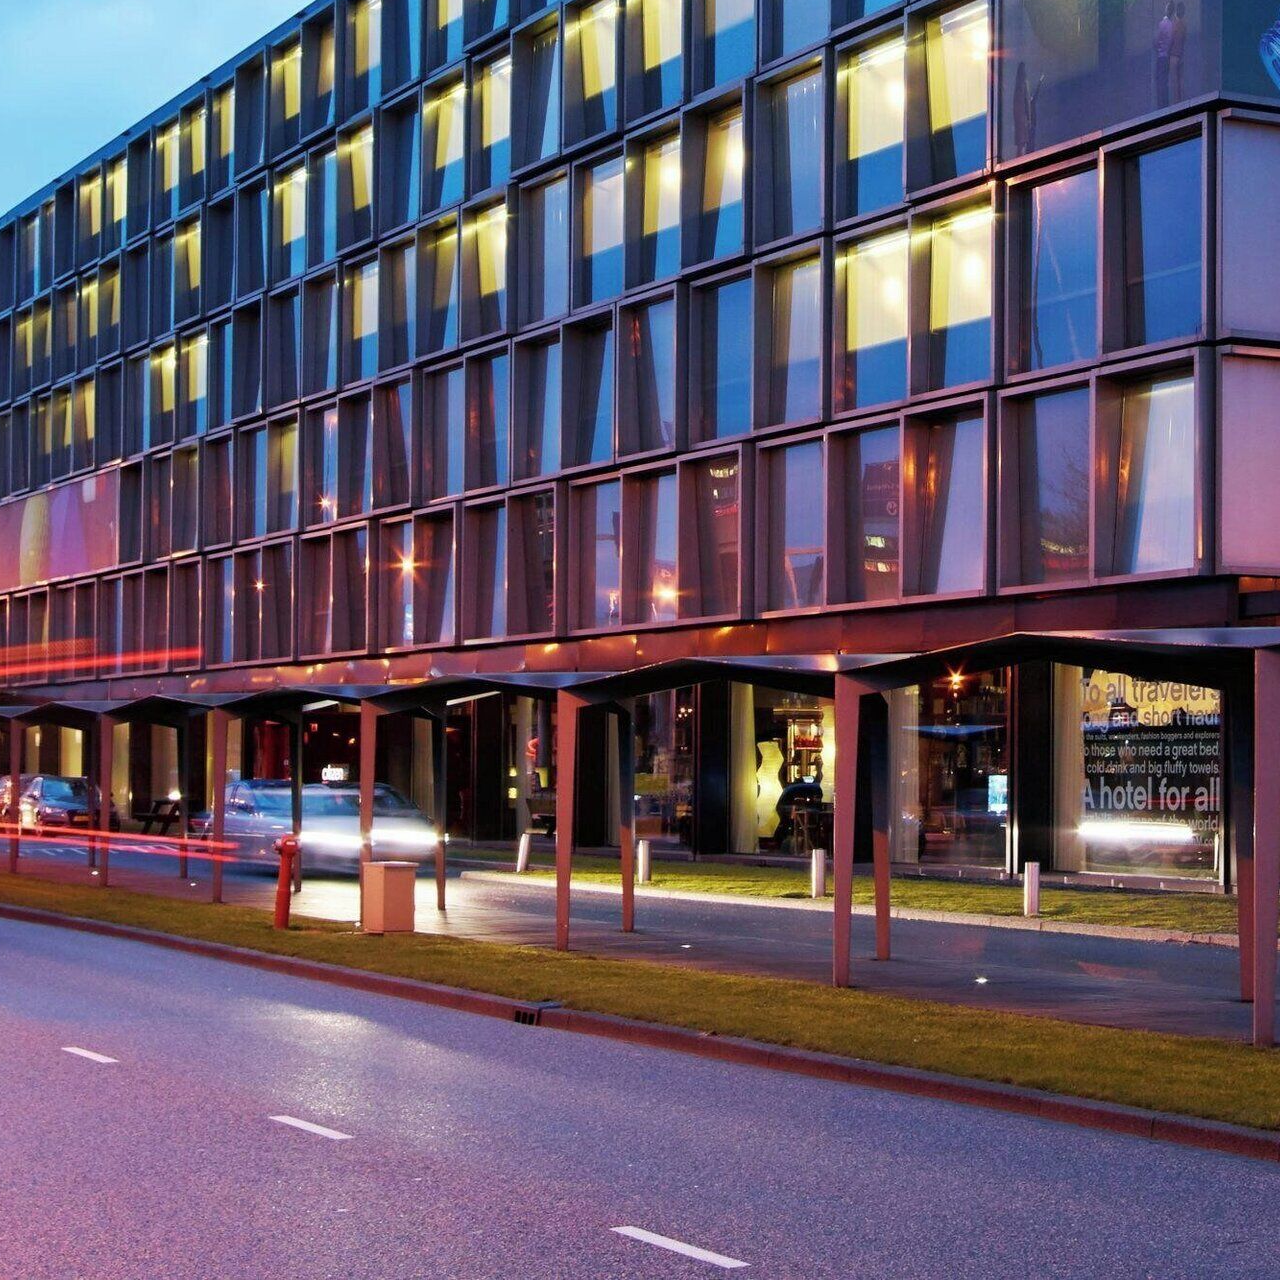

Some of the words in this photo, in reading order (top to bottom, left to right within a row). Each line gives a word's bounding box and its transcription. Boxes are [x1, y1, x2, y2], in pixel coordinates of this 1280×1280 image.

[1106, 675, 1126, 703] all
[1143, 705, 1181, 726] short
[1091, 743, 1116, 757] those
[1117, 742, 1137, 757] who
[1138, 742, 1163, 756] need
[1164, 746, 1170, 756] a
[1172, 743, 1198, 760] great
[1130, 761, 1146, 773] and
[1148, 760, 1162, 777] big
[1163, 760, 1188, 777] fluffy
[1082, 778, 1095, 809] A
[1100, 776, 1153, 810] hotel
[1158, 776, 1190, 811] for
[1194, 777, 1220, 811] all
[1187, 815, 1219, 831] world
